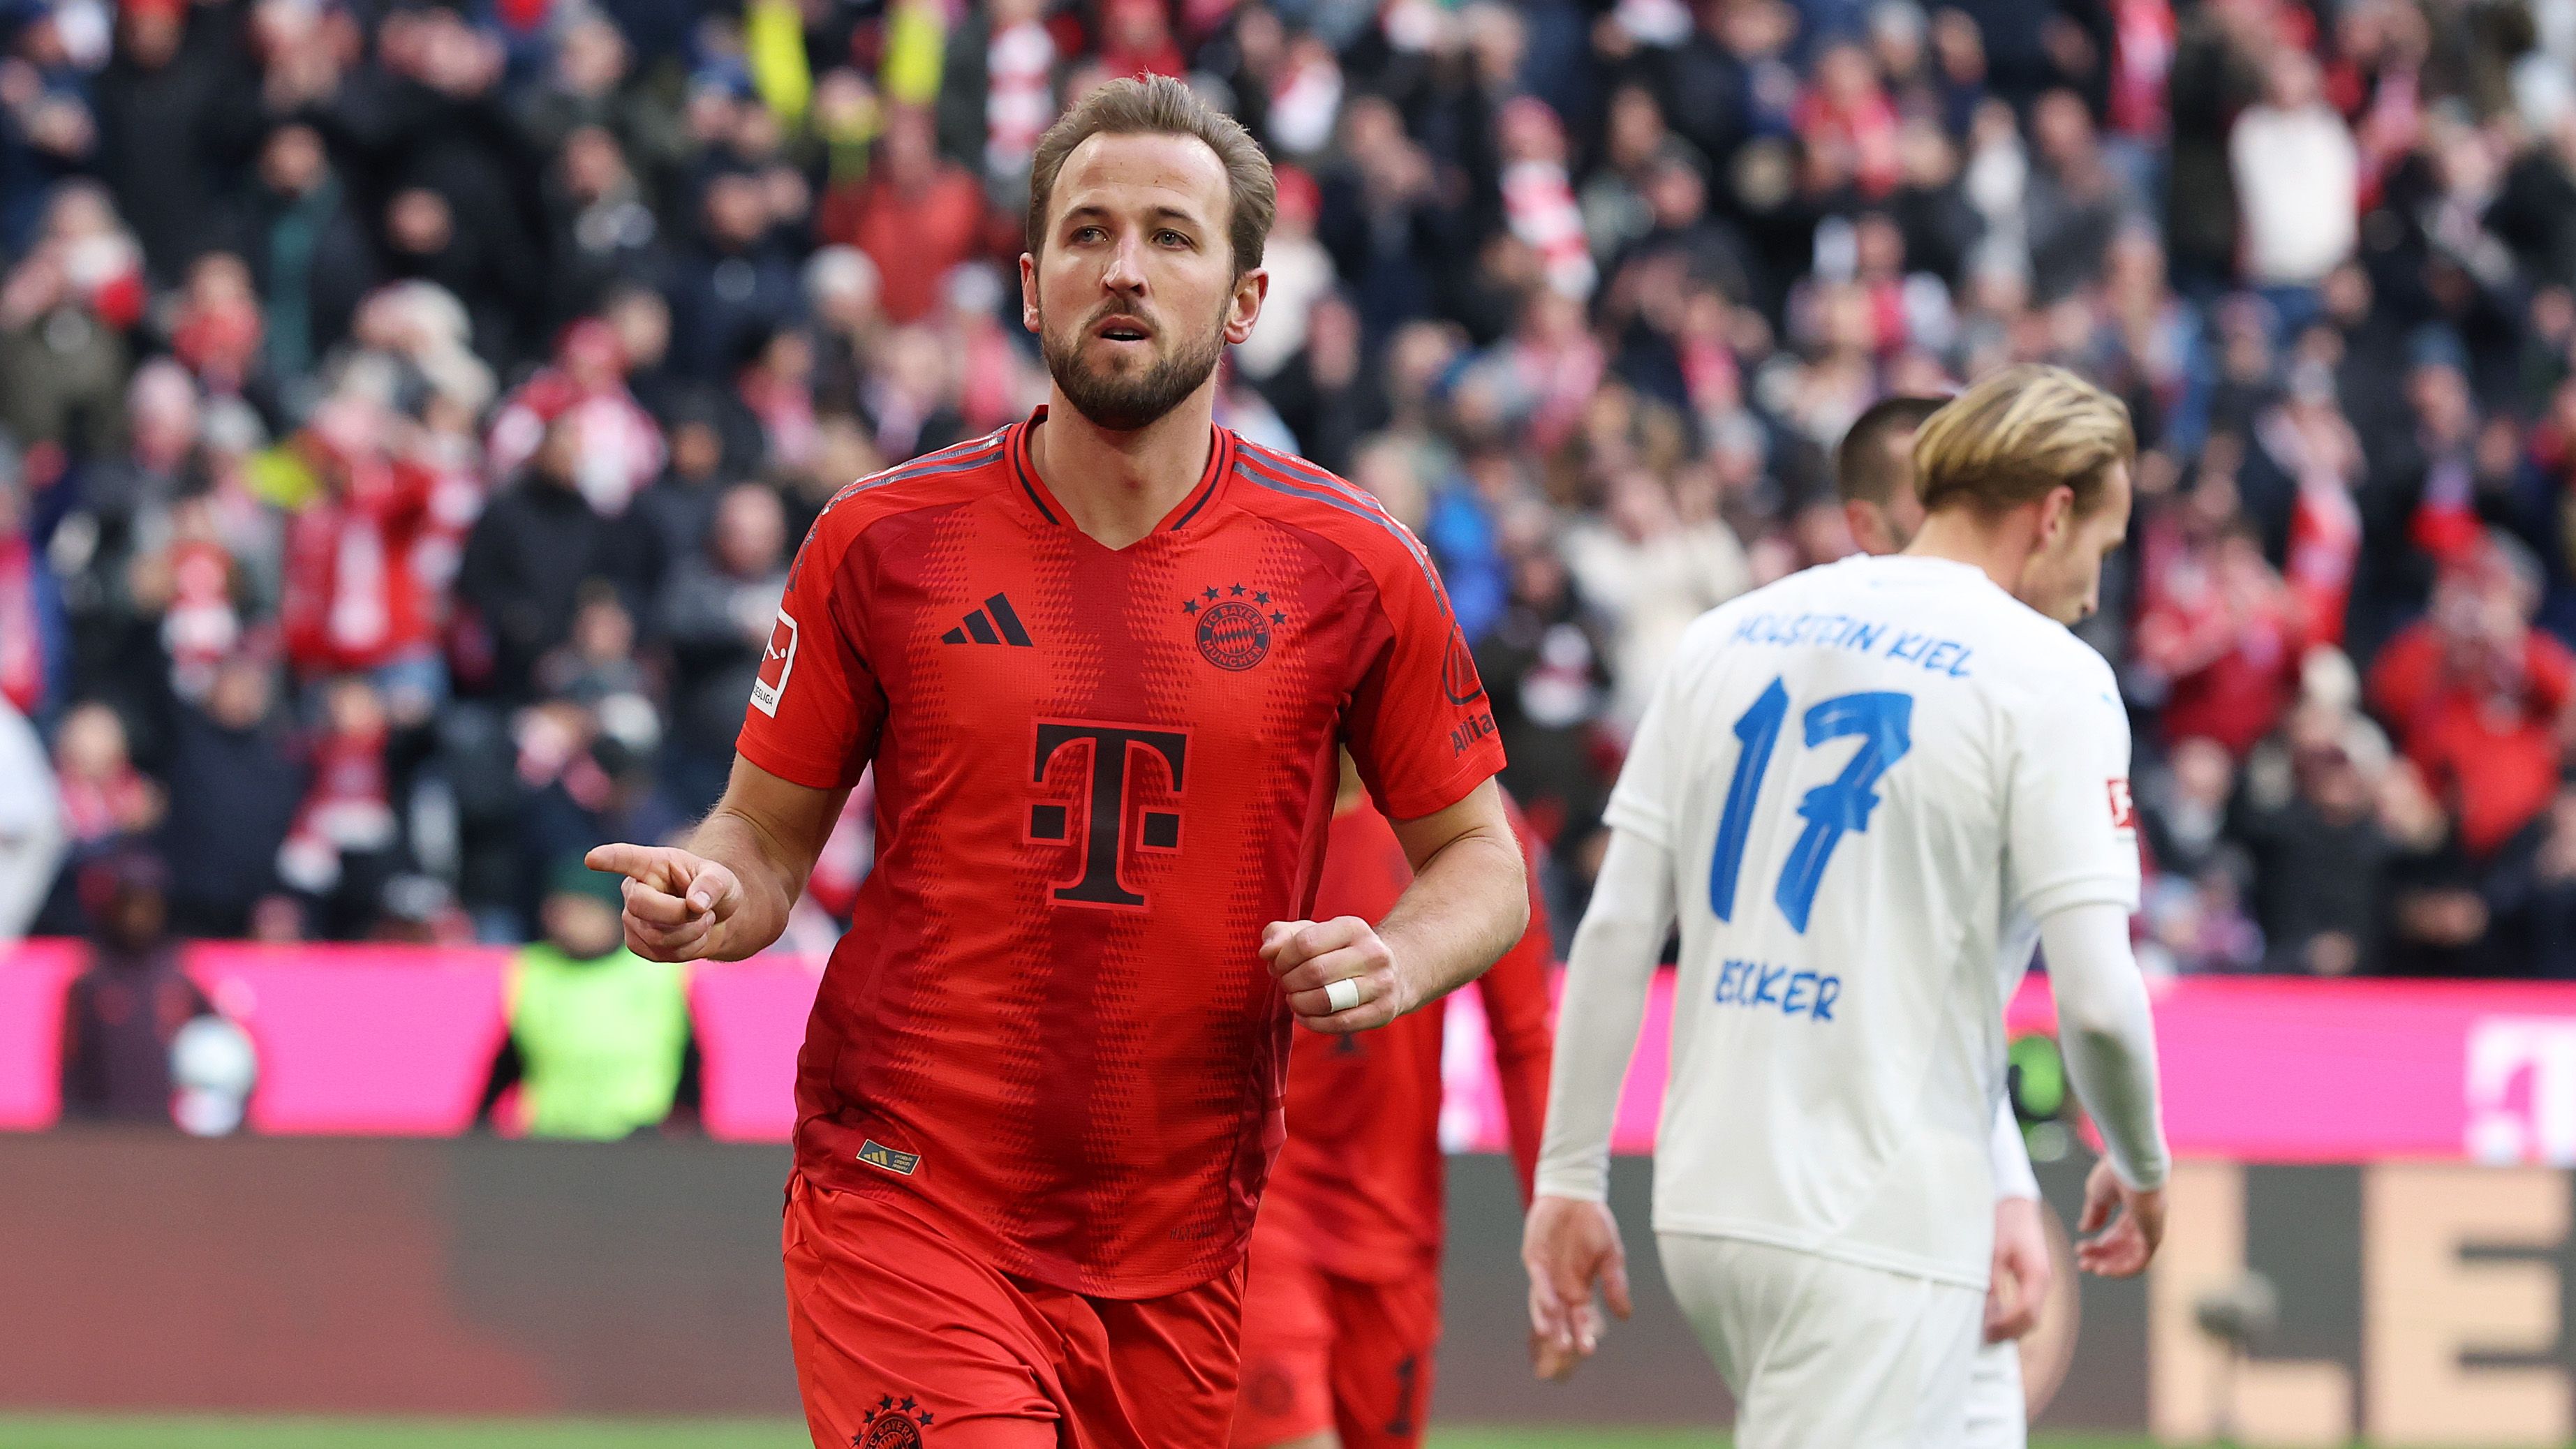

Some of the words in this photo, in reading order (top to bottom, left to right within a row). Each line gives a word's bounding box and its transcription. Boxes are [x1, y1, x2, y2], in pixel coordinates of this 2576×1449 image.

[1204, 613, 1219, 628] FC
[1220, 607, 1265, 634] BAYERN
[1885, 632, 1971, 677] KIEL
[753, 685, 773, 706] ESLIGA
[1028, 719, 1191, 910] T
[1711, 675, 1914, 935] 17
[877, 1420, 915, 1444] BAYERN
